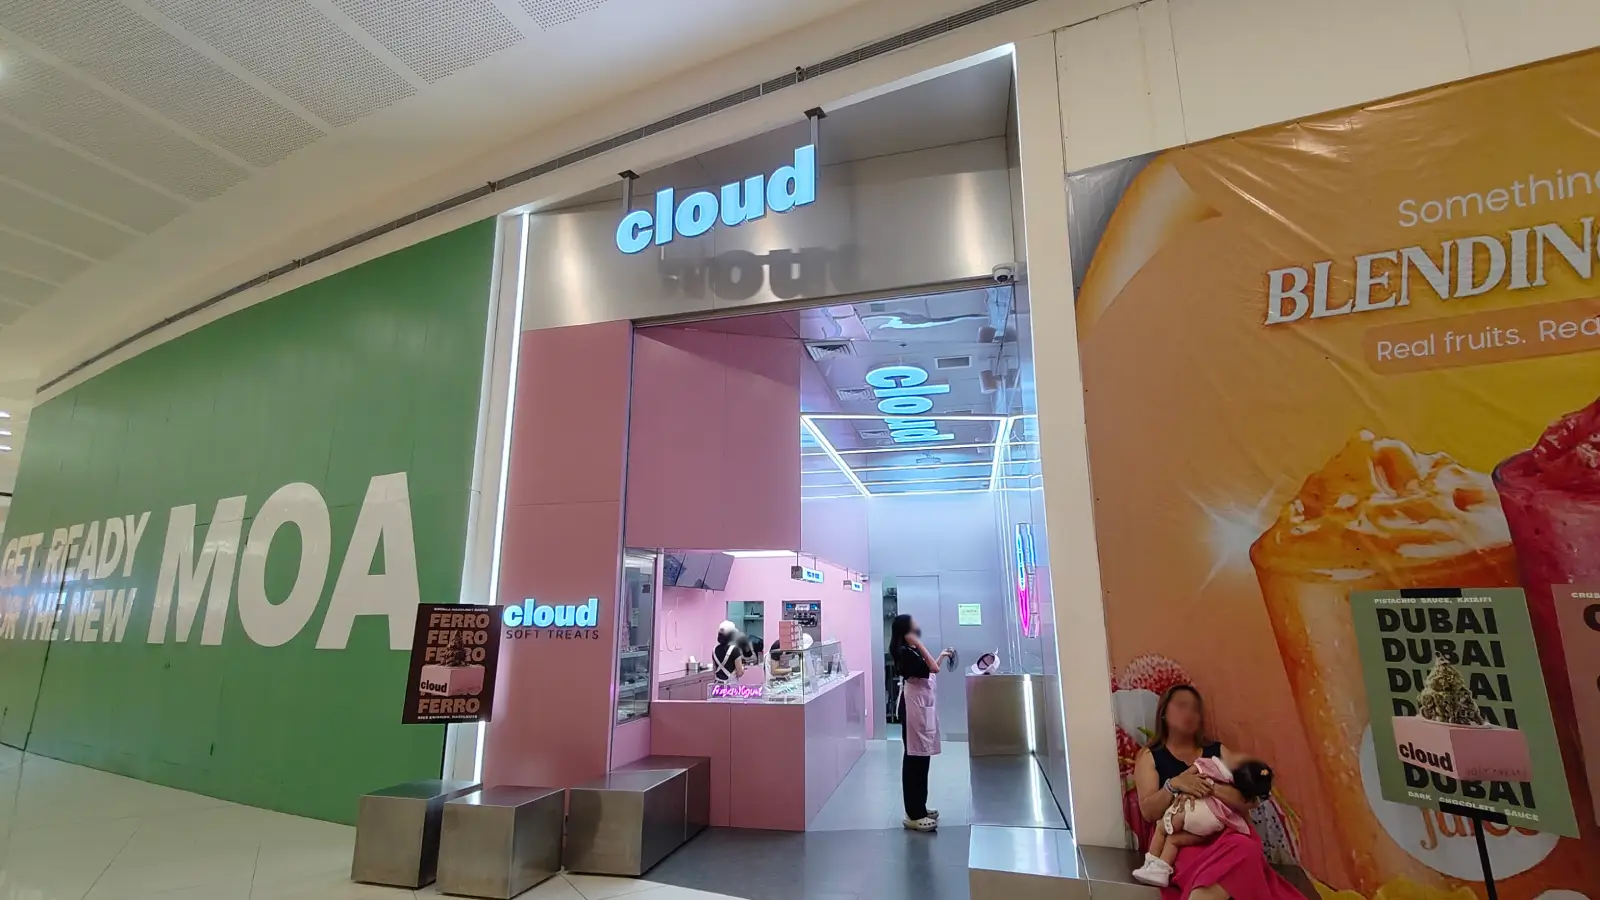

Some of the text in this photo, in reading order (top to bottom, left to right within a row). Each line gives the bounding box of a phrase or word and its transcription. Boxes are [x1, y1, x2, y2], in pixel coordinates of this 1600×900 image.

[616, 144, 817, 254] cloud
[1398, 168, 1600, 228] Somethin
[1264, 215, 1600, 325] BLENDIN
[1377, 335, 1435, 361] Real
[1444, 325, 1526, 354] fruits.
[1, 511, 152, 588] GET READY
[147, 471, 421, 650] MOA
[64, 587, 138, 643] NEW
[429, 613, 490, 628] FERRO
[503, 597, 599, 628] cloud
[1376, 607, 1498, 634] DUBAI
[506, 629, 599, 640] SOFT TREATS
[425, 647, 486, 662] FERO
[1382, 637, 1506, 668] DUBAI
[420, 680, 447, 693] cloud
[1387, 668, 1513, 701] DUAI
[418, 698, 480, 713] FERRO
[1399, 741, 1454, 772] cloud
[1404, 761, 1536, 809] DUBAI
[1408, 791, 1432, 801] DARK
[1504, 808, 1539, 821] SAUCE
